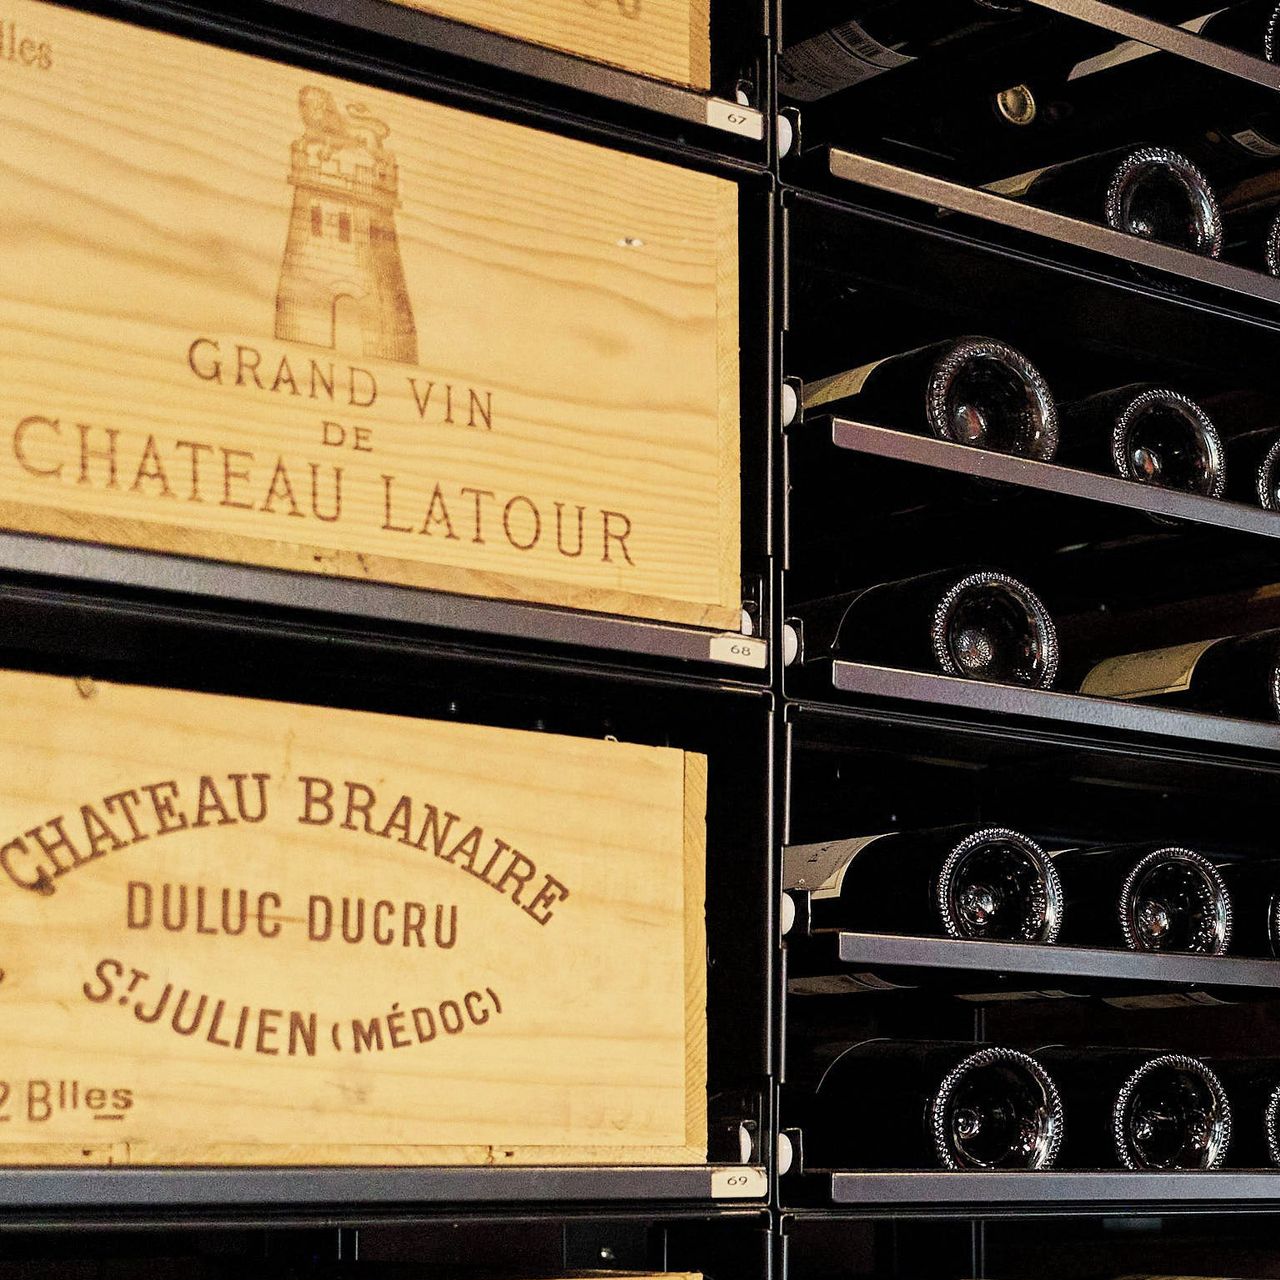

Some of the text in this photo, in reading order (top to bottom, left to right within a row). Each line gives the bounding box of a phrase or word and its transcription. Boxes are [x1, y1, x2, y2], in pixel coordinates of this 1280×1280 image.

[727, 114, 747, 127] 67
[188, 338, 495, 430] GRAND VIN
[320, 420, 375, 452] DE
[12, 414, 636, 566] CHATEAU LATOUR
[730, 645, 751, 658] 68
[0, 772, 571, 926] CHATEAU BRANAIRE
[126, 880, 459, 949] DULUC DUCRU
[26, 1079, 134, 1121] Blles
[727, 1176, 748, 1187] 69
